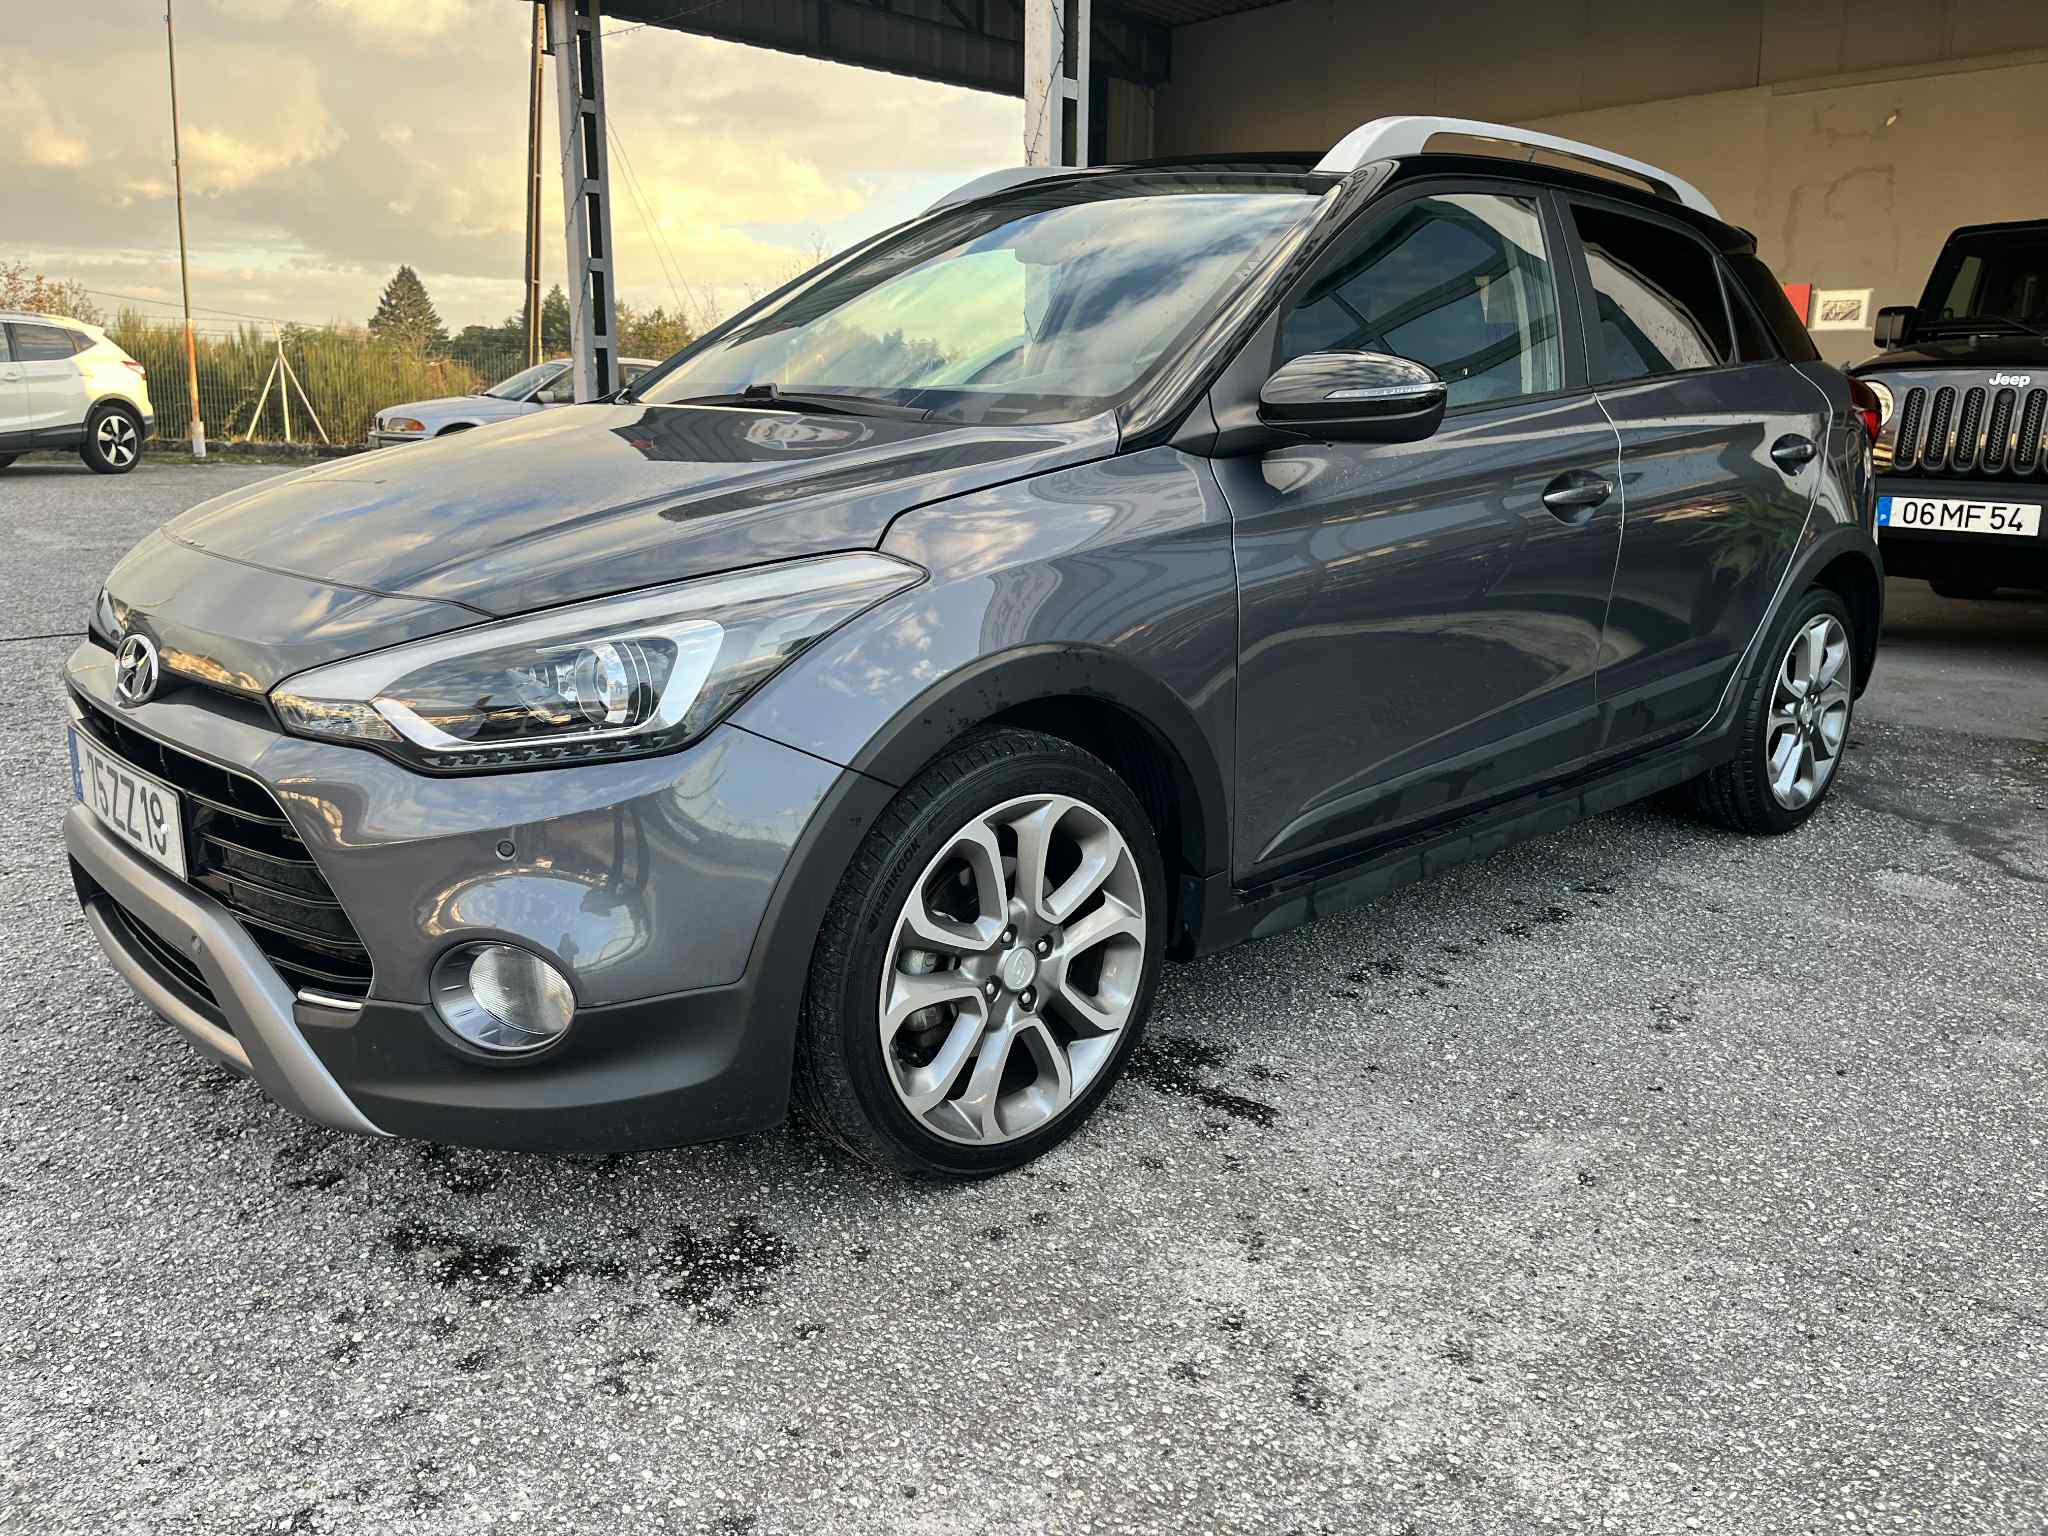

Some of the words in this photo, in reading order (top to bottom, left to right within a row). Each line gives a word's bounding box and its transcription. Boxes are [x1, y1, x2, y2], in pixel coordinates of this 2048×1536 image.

[1988, 372, 2031, 388] Jeep
[1902, 501, 1936, 525] 06
[1940, 503, 1986, 529] MF
[1990, 506, 2023, 532] 54
